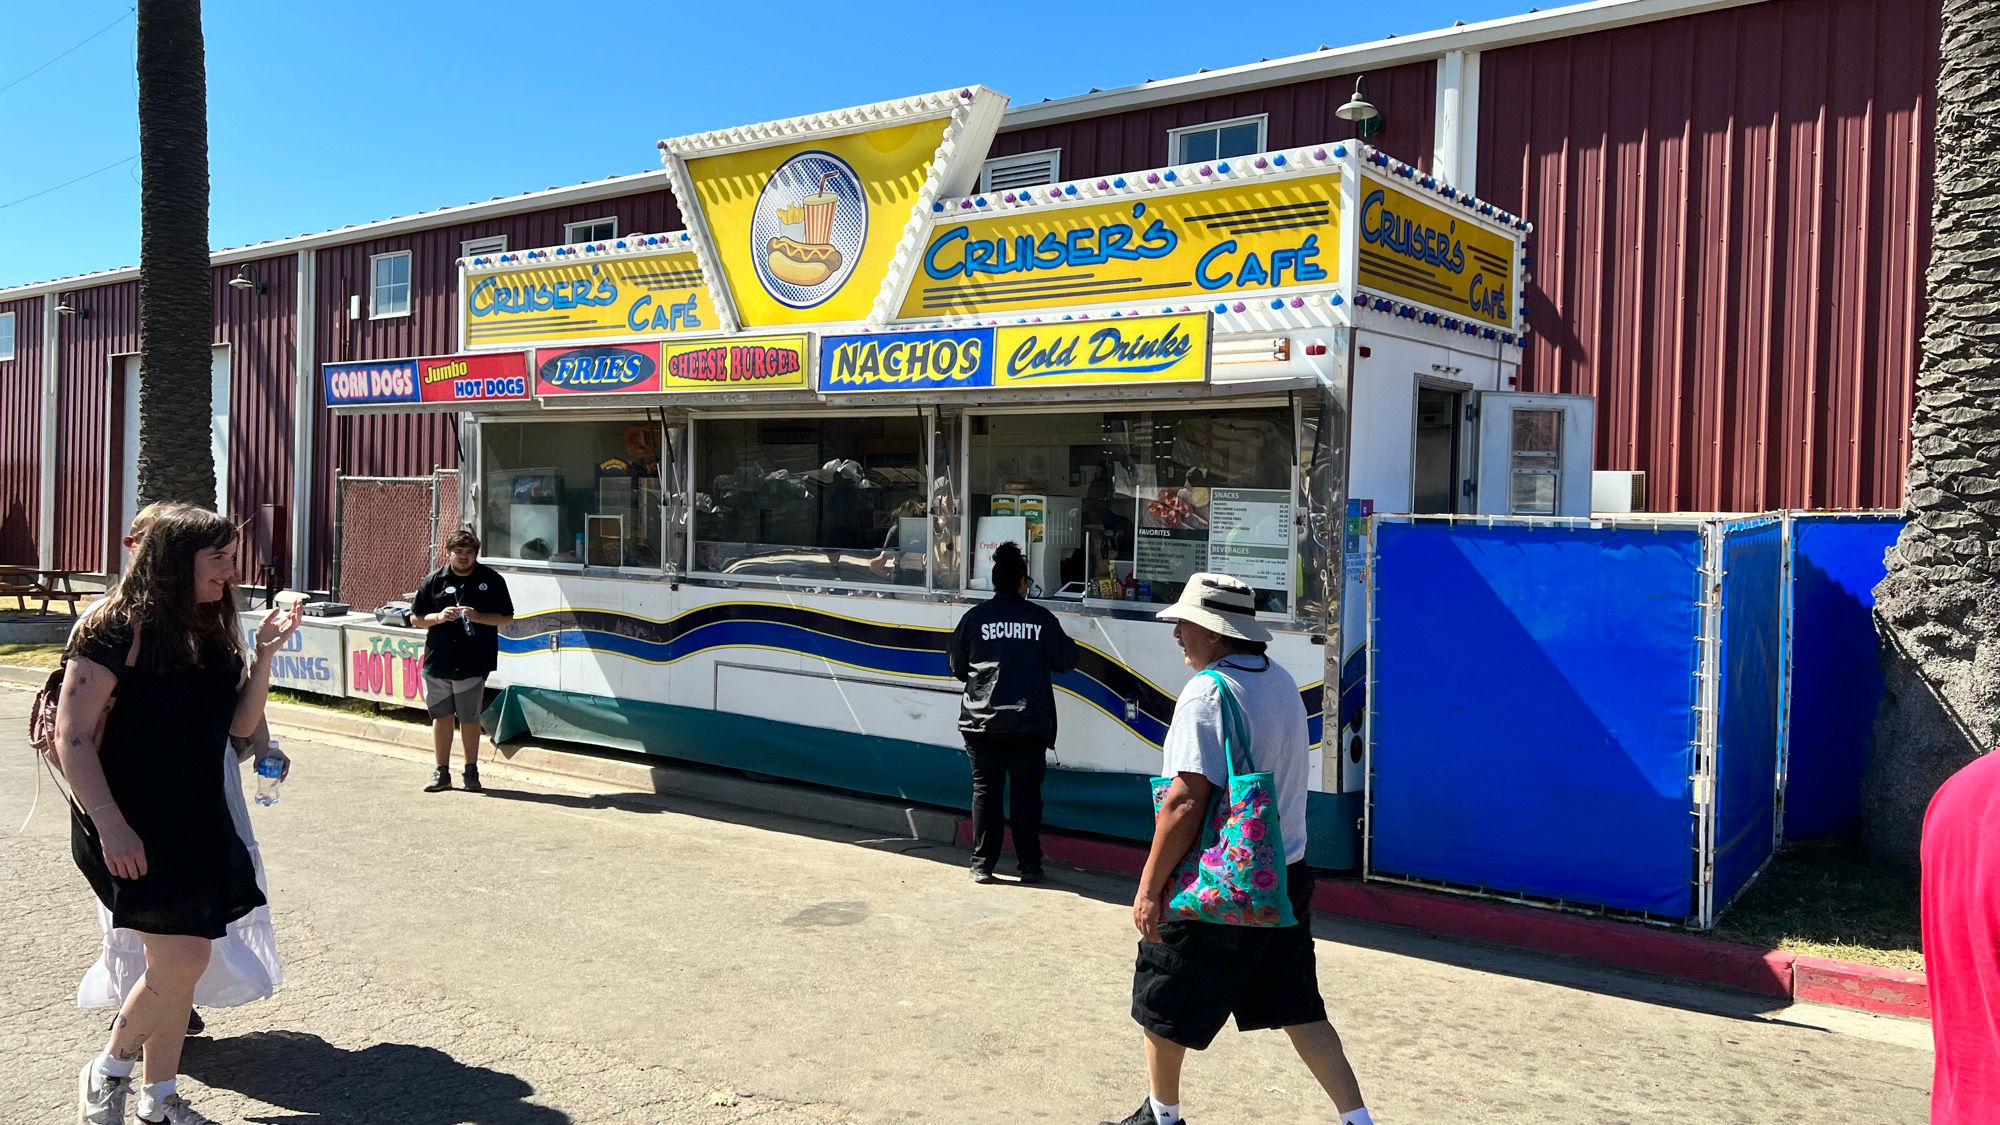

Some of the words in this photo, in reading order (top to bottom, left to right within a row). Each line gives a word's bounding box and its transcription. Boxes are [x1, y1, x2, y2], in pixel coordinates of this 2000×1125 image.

[924, 202, 1179, 280] CRUISER'S
[1360, 189, 1465, 275] CRUISER'S
[1194, 233, 1328, 290] CAFÉ
[469, 263, 618, 317] CRUISER'S
[1469, 273, 1507, 320] CAFÉ
[627, 293, 701, 331] CAFÉ
[668, 347, 727, 381] CHEESE
[730, 346, 800, 381] BURGER
[829, 338, 982, 384] NACHOS
[1006, 334, 1080, 377] Cold
[1087, 322, 1193, 364] Drinks
[331, 370, 369, 398] CORN
[370, 368, 413, 397] DOGS
[424, 360, 468, 384] Jumbo
[454, 380, 483, 398] HOT
[485, 377, 525, 396] DOGS
[551, 354, 643, 385] FRIES
[1138, 528, 1171, 537] FAVORITES
[1212, 546, 1249, 554] BEVERAGES
[981, 621, 1042, 641] SECURITY
[270, 655, 331, 681] RINKS
[353, 650, 394, 696] HOT
